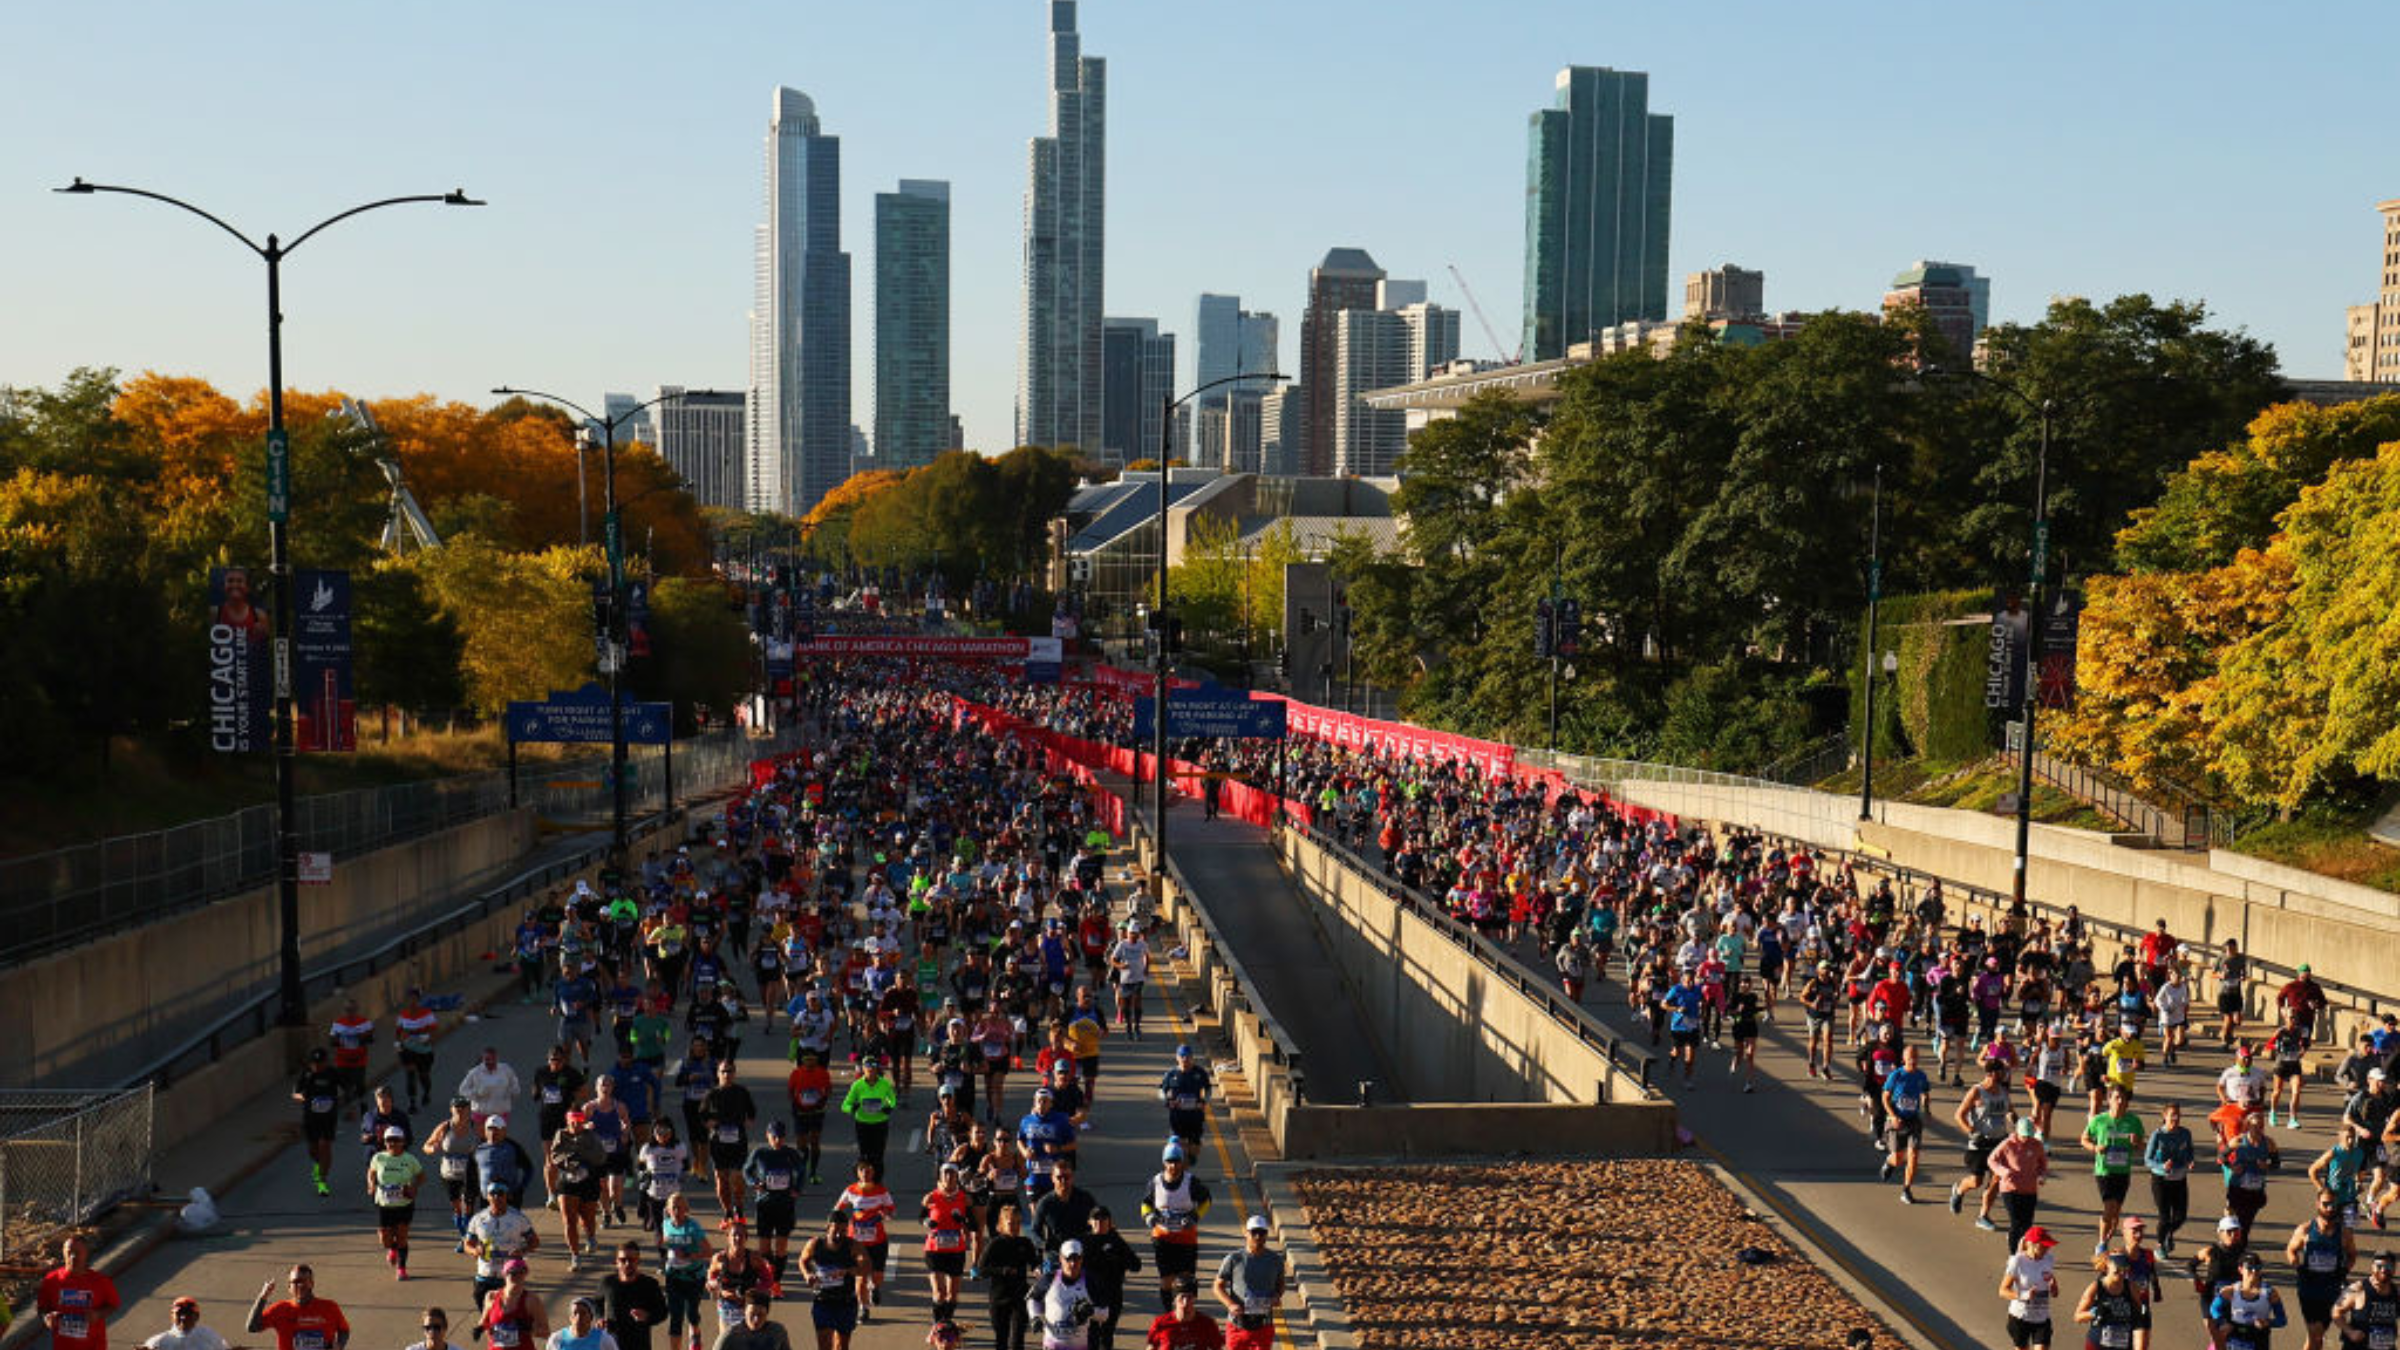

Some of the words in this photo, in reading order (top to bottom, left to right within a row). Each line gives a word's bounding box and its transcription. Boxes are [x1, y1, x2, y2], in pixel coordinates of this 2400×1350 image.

[210, 623, 236, 752] CHICAGO
[850, 640, 904, 653] AMERICA
[906, 640, 957, 653] CHICAGO
[959, 641, 1025, 654] MARATHON
[1985, 623, 2007, 708] CHICAGO
